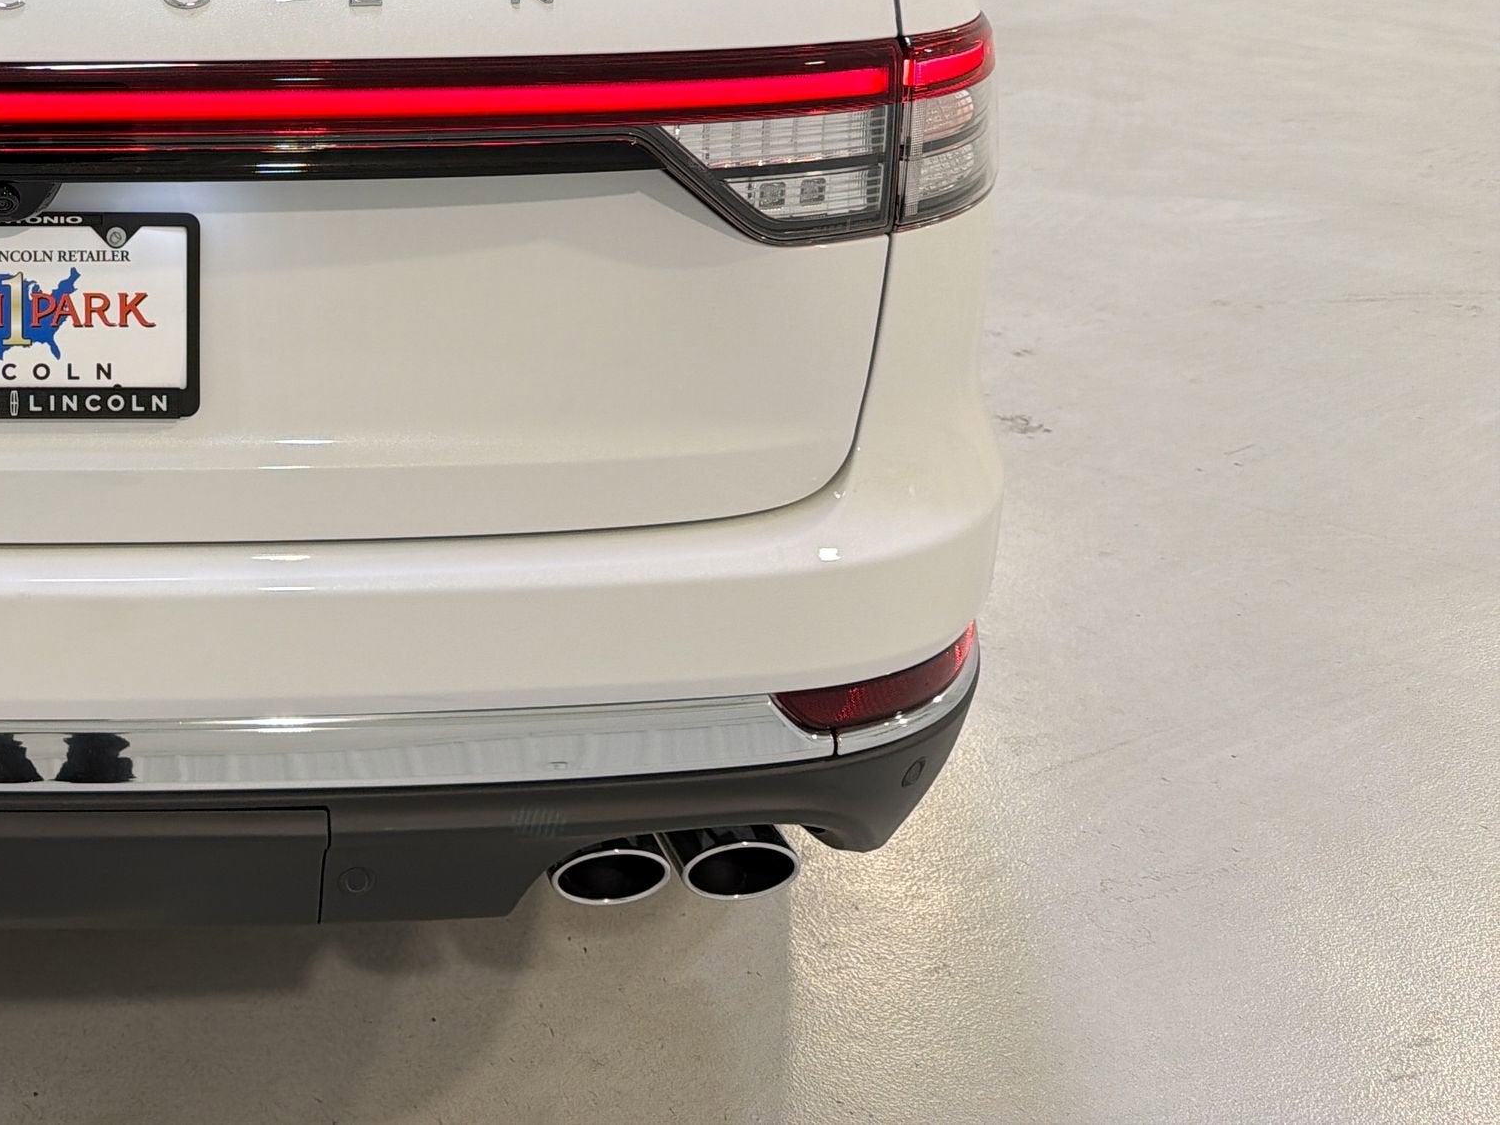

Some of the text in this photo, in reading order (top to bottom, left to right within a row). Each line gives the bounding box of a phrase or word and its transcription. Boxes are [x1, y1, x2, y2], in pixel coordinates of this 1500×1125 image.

[57, 250, 131, 263] RETAILER
[31, 292, 156, 328] PARK
[29, 394, 168, 412] LINCOLN
